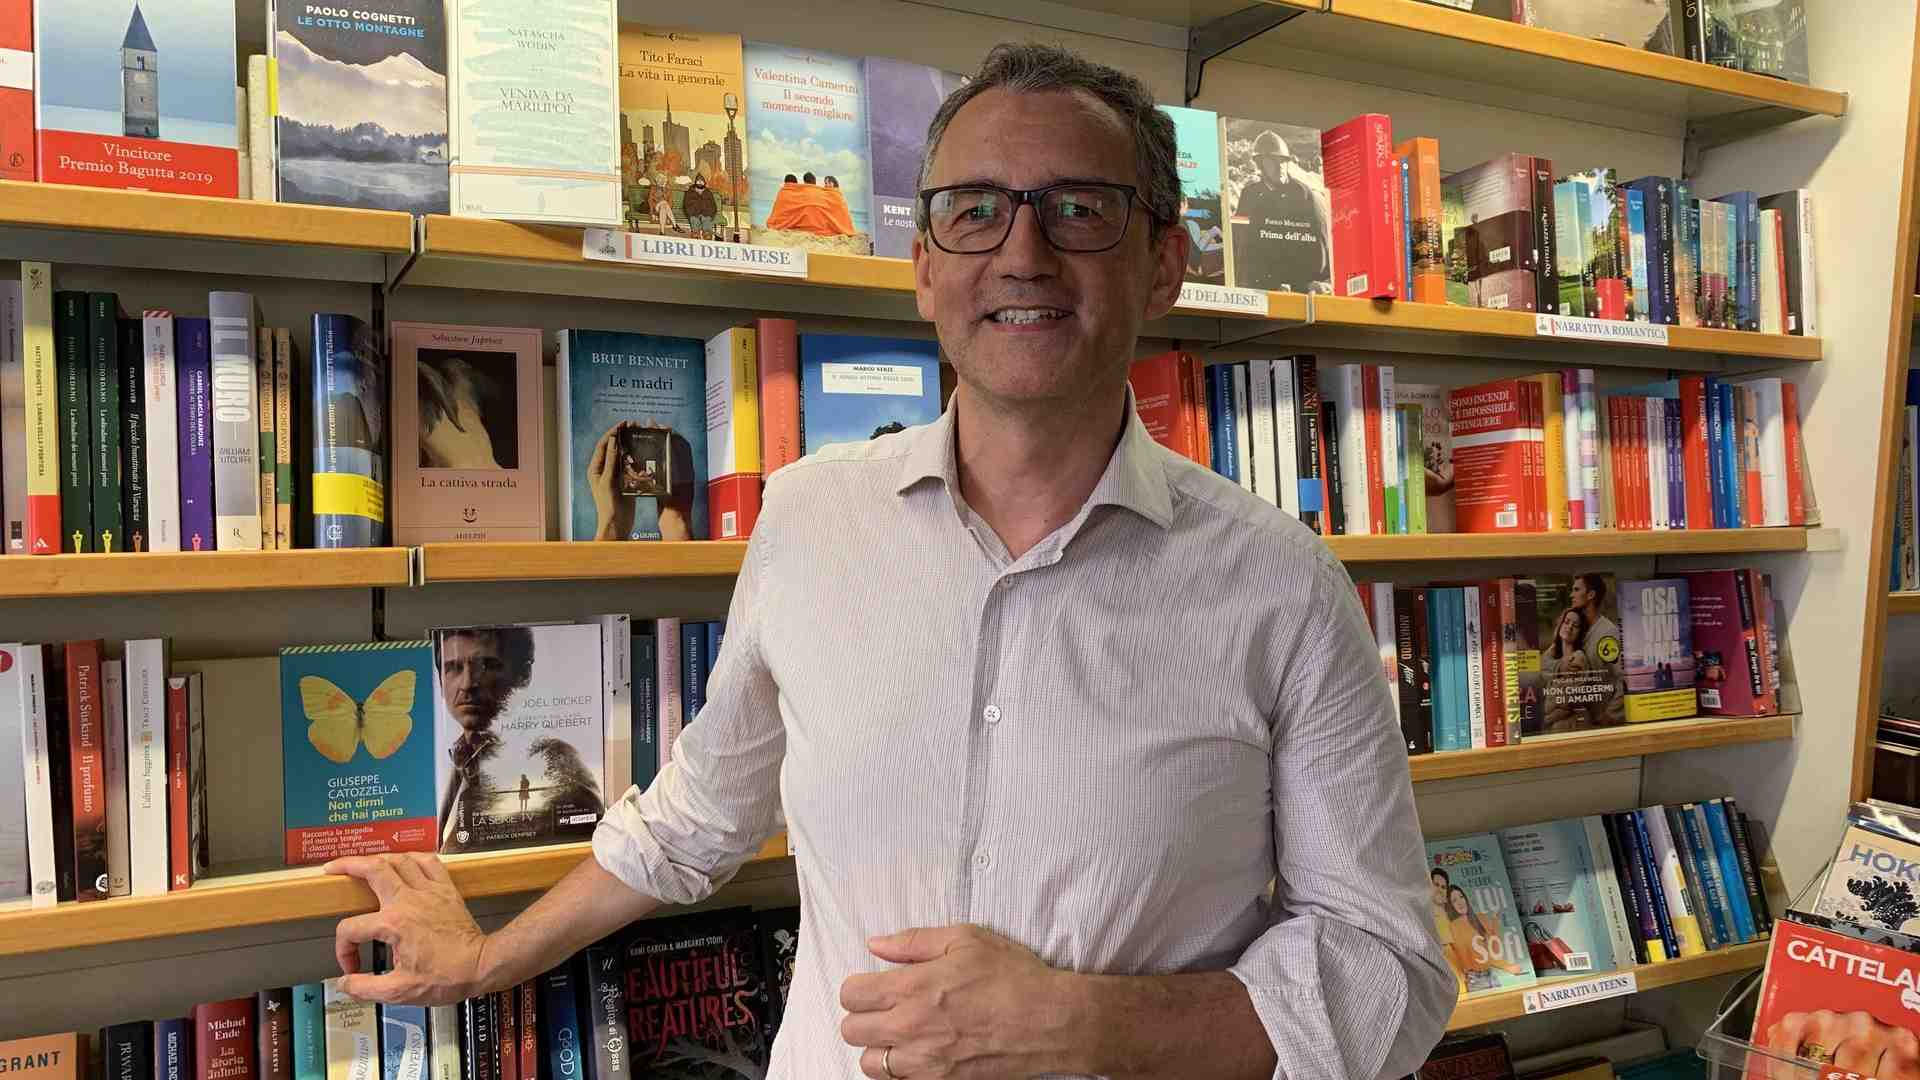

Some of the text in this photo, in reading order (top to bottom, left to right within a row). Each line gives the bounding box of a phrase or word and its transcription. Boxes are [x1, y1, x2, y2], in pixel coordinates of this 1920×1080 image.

[306, 5, 416, 26] PAOLO COGNETTI
[297, 16, 425, 39] LE OTTO MONTAGNE
[640, 49, 703, 67] Tito Faraci
[619, 65, 726, 88] La vita in generale
[753, 67, 806, 87] Valentina
[793, 91, 834, 106] secondo
[762, 101, 812, 115] momento
[103, 142, 173, 162] Vincitore
[59, 156, 215, 185] Premio Bagutta 2019
[884, 204, 912, 217] KENT
[1259, 229, 1284, 241] Prima
[640, 239, 791, 266] LIBRI DEL MESE
[1194, 289, 1220, 305] DEL
[1222, 291, 1258, 307] MESE
[1554, 319, 1667, 341] NARRATIVA ROMANTICA
[592, 351, 689, 369] BRIT BENNETT
[608, 373, 673, 391] Le madri
[420, 476, 518, 490] La cattiva strada
[78, 665, 91, 703] Patrick
[1543, 684, 1614, 697] NON CHIEDERMI
[552, 695, 592, 706] DICKER
[1555, 693, 1603, 705] DI AMARTI
[501, 716, 592, 731] HARRY QUEBERT
[327, 774, 380, 788] GIUSEPPE
[80, 767, 95, 813] profumo
[328, 784, 399, 800] CATOZZELLA
[328, 796, 384, 811] Non dirmi
[328, 808, 404, 822] che hai paura
[302, 830, 334, 839] Racconta
[1541, 977, 1628, 1004] NARRATIVA TEENS
[207, 1016, 246, 1032] Michael
[214, 1029, 240, 1041] Ende
[220, 1046, 235, 1056] La
